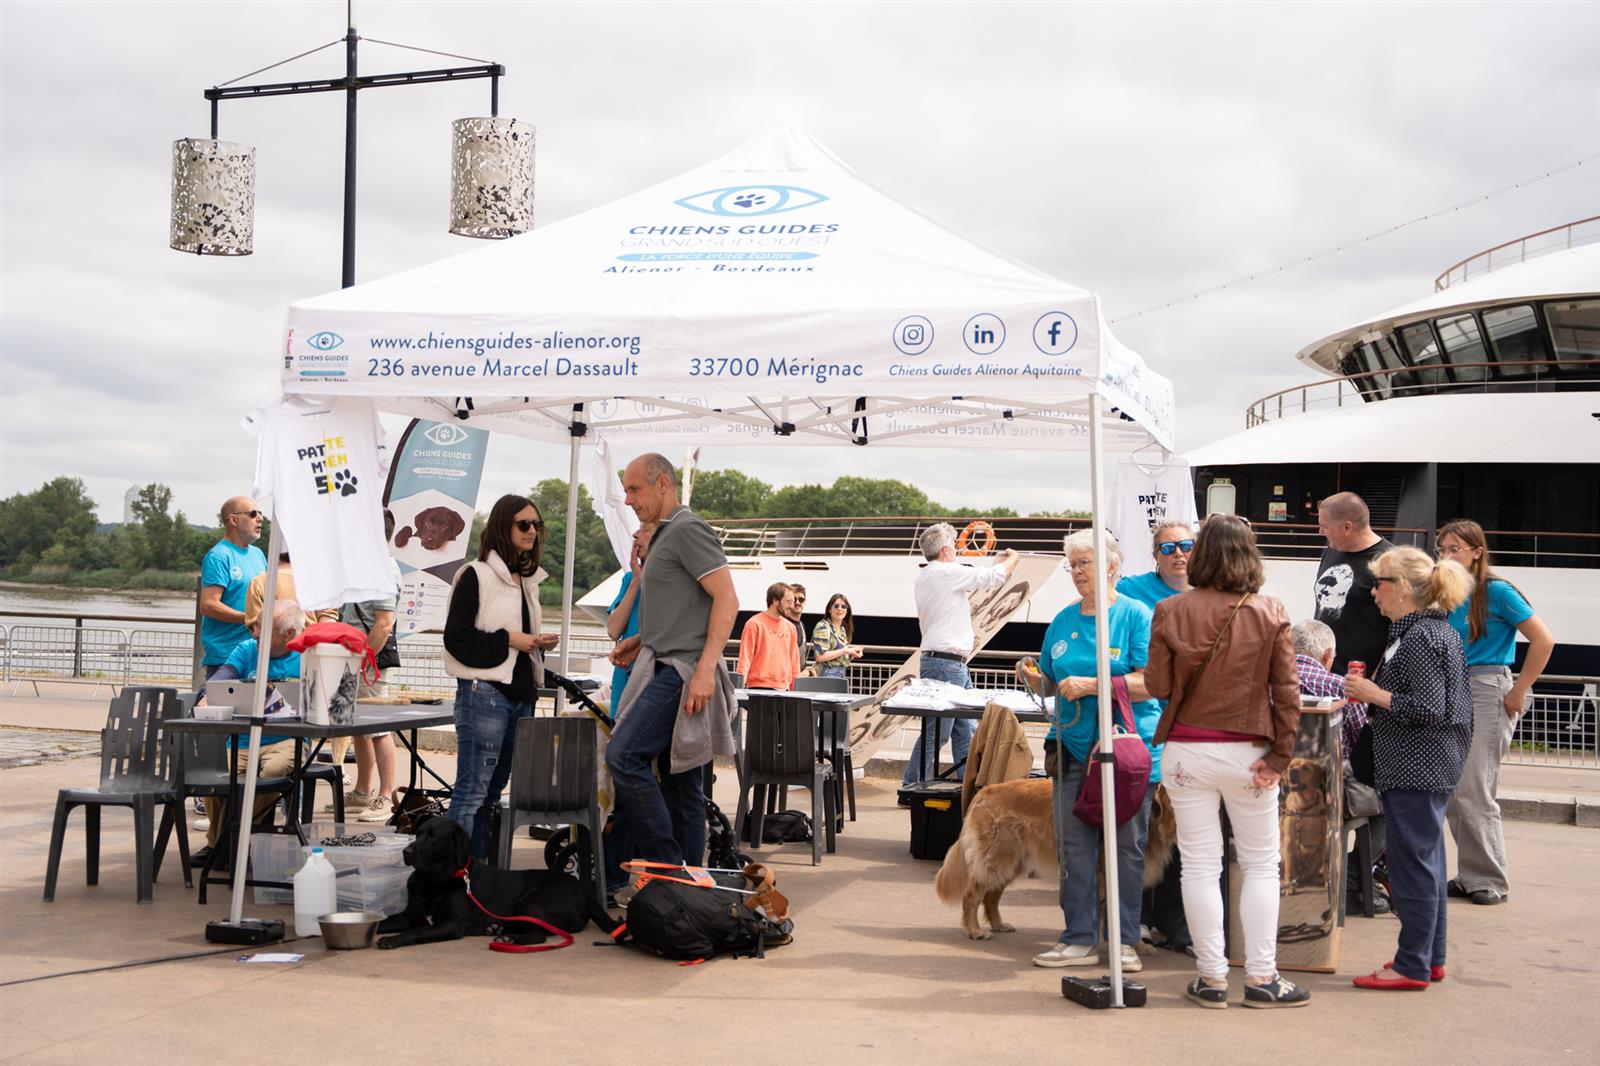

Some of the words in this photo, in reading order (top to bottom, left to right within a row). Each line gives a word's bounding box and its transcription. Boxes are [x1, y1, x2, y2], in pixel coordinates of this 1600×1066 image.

[629, 225, 730, 236] CHIENS
[738, 223, 840, 235] GUIDES
[619, 237, 703, 248] GRAND
[704, 237, 755, 248] SUD
[757, 236, 833, 248] OUEST
[712, 263, 815, 273] Bordeaux
[369, 331, 641, 355] www.chiensguides-alienor.org
[368, 358, 405, 376] 236
[411, 362, 476, 377] avenue
[482, 357, 549, 377] Marcel
[556, 356, 639, 376] Dassault
[689, 357, 760, 376] 33700
[766, 356, 864, 384] Mérignac
[889, 364, 929, 376] Chiens
[932, 363, 972, 376] Guides
[975, 363, 1020, 376] Aliénor
[1022, 363, 1083, 380] Aquitaine
[297, 436, 345, 460] PATTE
[442, 450, 472, 460] GUIDES
[1138, 491, 1168, 504] PATTE
